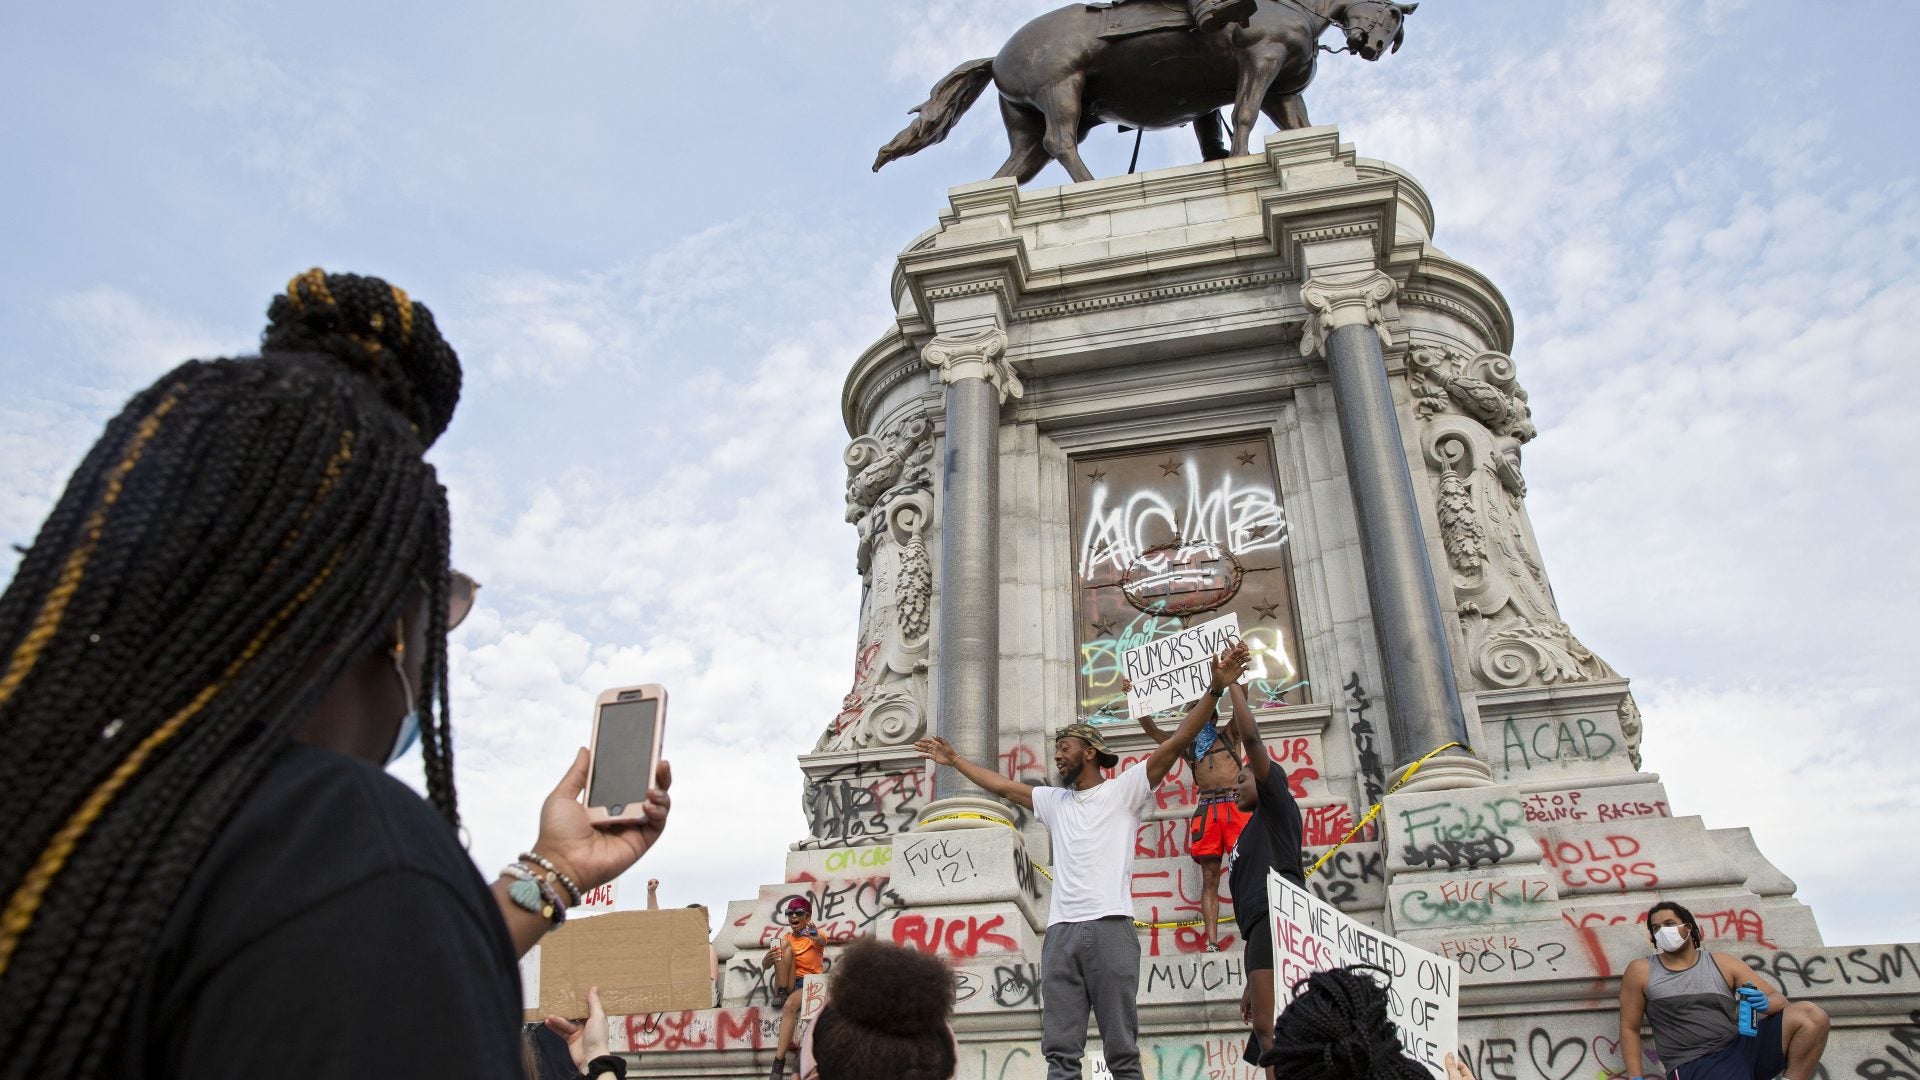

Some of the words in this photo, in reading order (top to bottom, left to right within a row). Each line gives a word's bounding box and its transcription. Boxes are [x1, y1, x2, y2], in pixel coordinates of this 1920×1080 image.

[1080, 458, 1293, 580] ACAB
[1126, 633, 1193, 681] RUMORS
[1188, 625, 1207, 640] OF
[1198, 624, 1241, 655] WAR
[1133, 665, 1189, 699] WASN'T
[1171, 687, 1184, 704] A
[1503, 715, 1616, 771] ACAB
[1598, 801, 1669, 822] RACIST
[904, 838, 962, 876] FUCK
[936, 851, 977, 887] 12!
[1561, 862, 1659, 888] COPS
[585, 885, 613, 906] EACE
[1313, 881, 1359, 905] 12
[1440, 880, 1511, 905] FUCK
[1523, 879, 1555, 903] 12
[893, 914, 1020, 958] FUCK
[1274, 879, 1307, 920] IF
[1307, 898, 1335, 943] WE
[1417, 960, 1451, 998] ON
[1503, 936, 1519, 949] 12
[1147, 957, 1242, 993] MUCH
[1276, 916, 1335, 972] NECKS
[1411, 997, 1439, 1031] OF
[624, 1007, 761, 1052] BLM
[1394, 1024, 1444, 1072] OLICE
